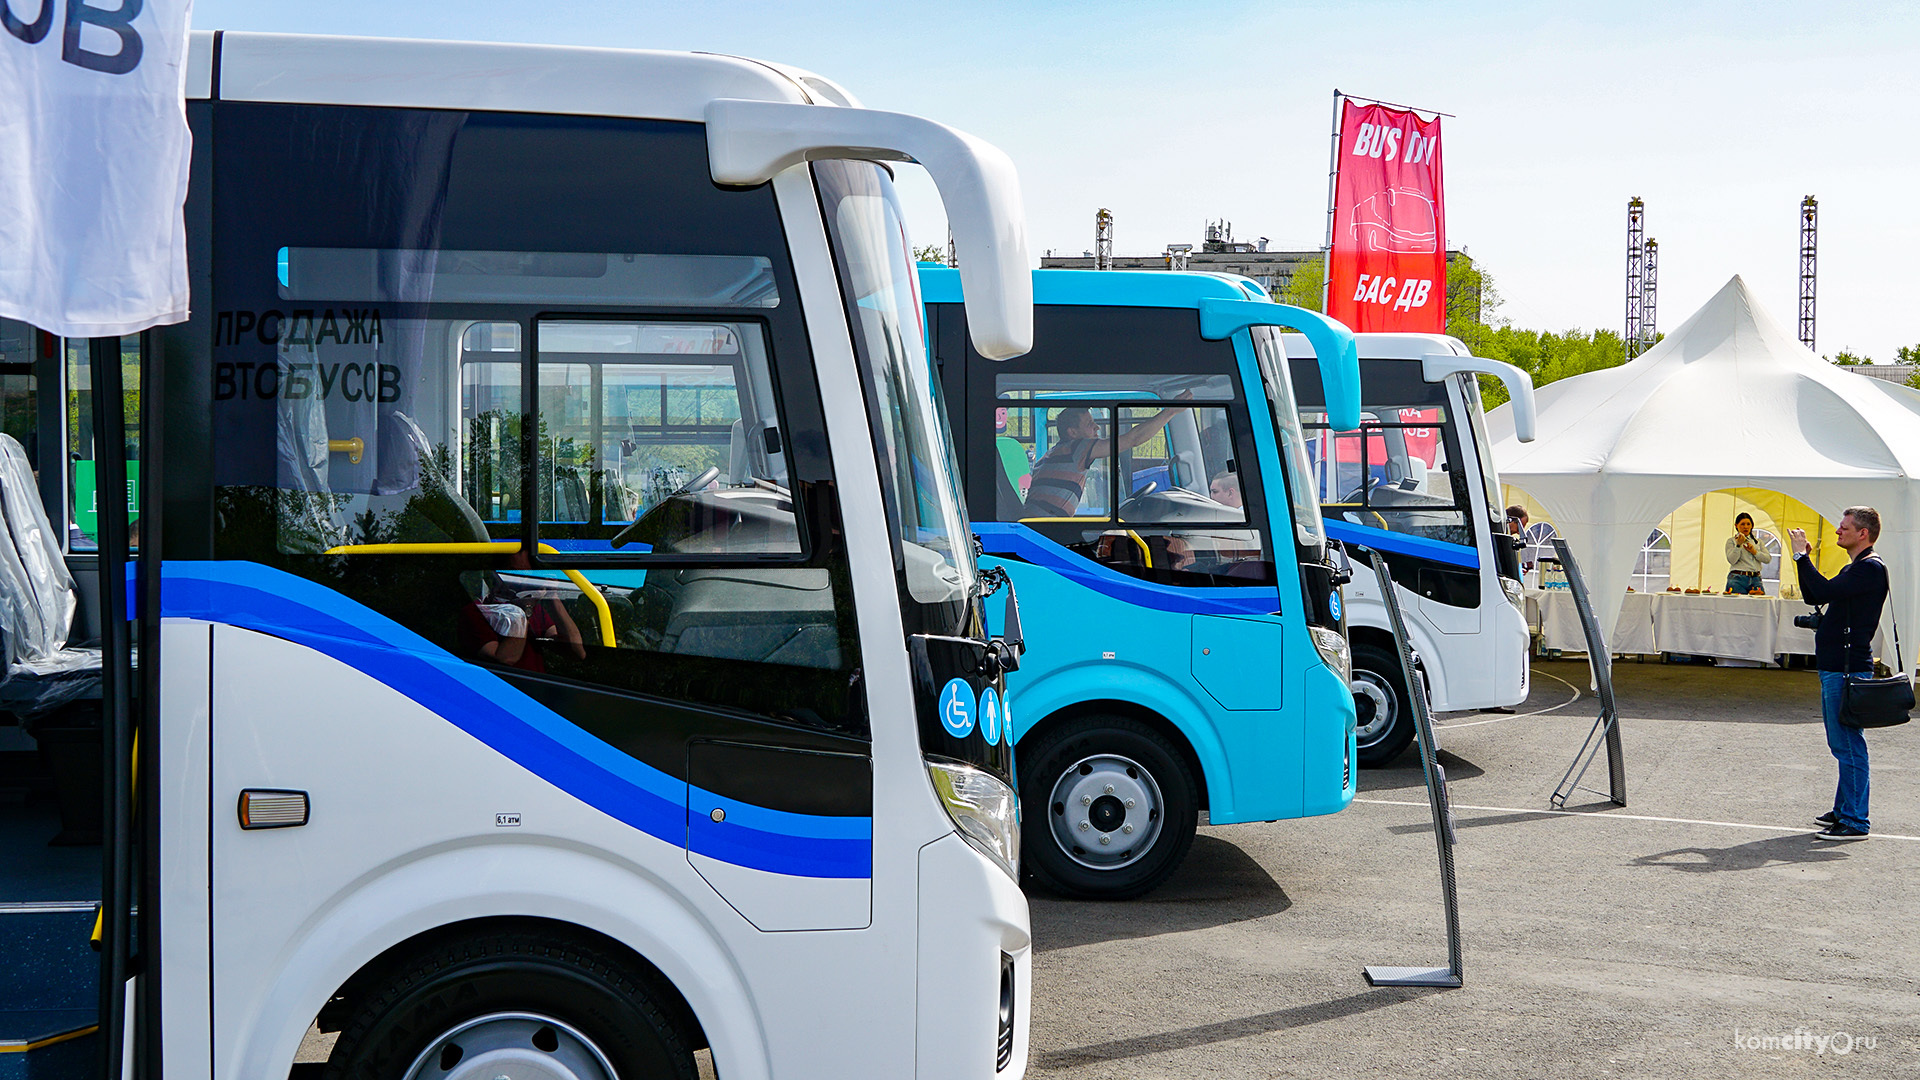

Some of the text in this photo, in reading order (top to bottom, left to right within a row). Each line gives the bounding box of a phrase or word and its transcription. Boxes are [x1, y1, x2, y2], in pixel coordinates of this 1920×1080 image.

[1352, 122, 1402, 162] BUS
[1353, 273, 1432, 313] БАС ДВ
[215, 308, 385, 353] ПРОДАЖА
